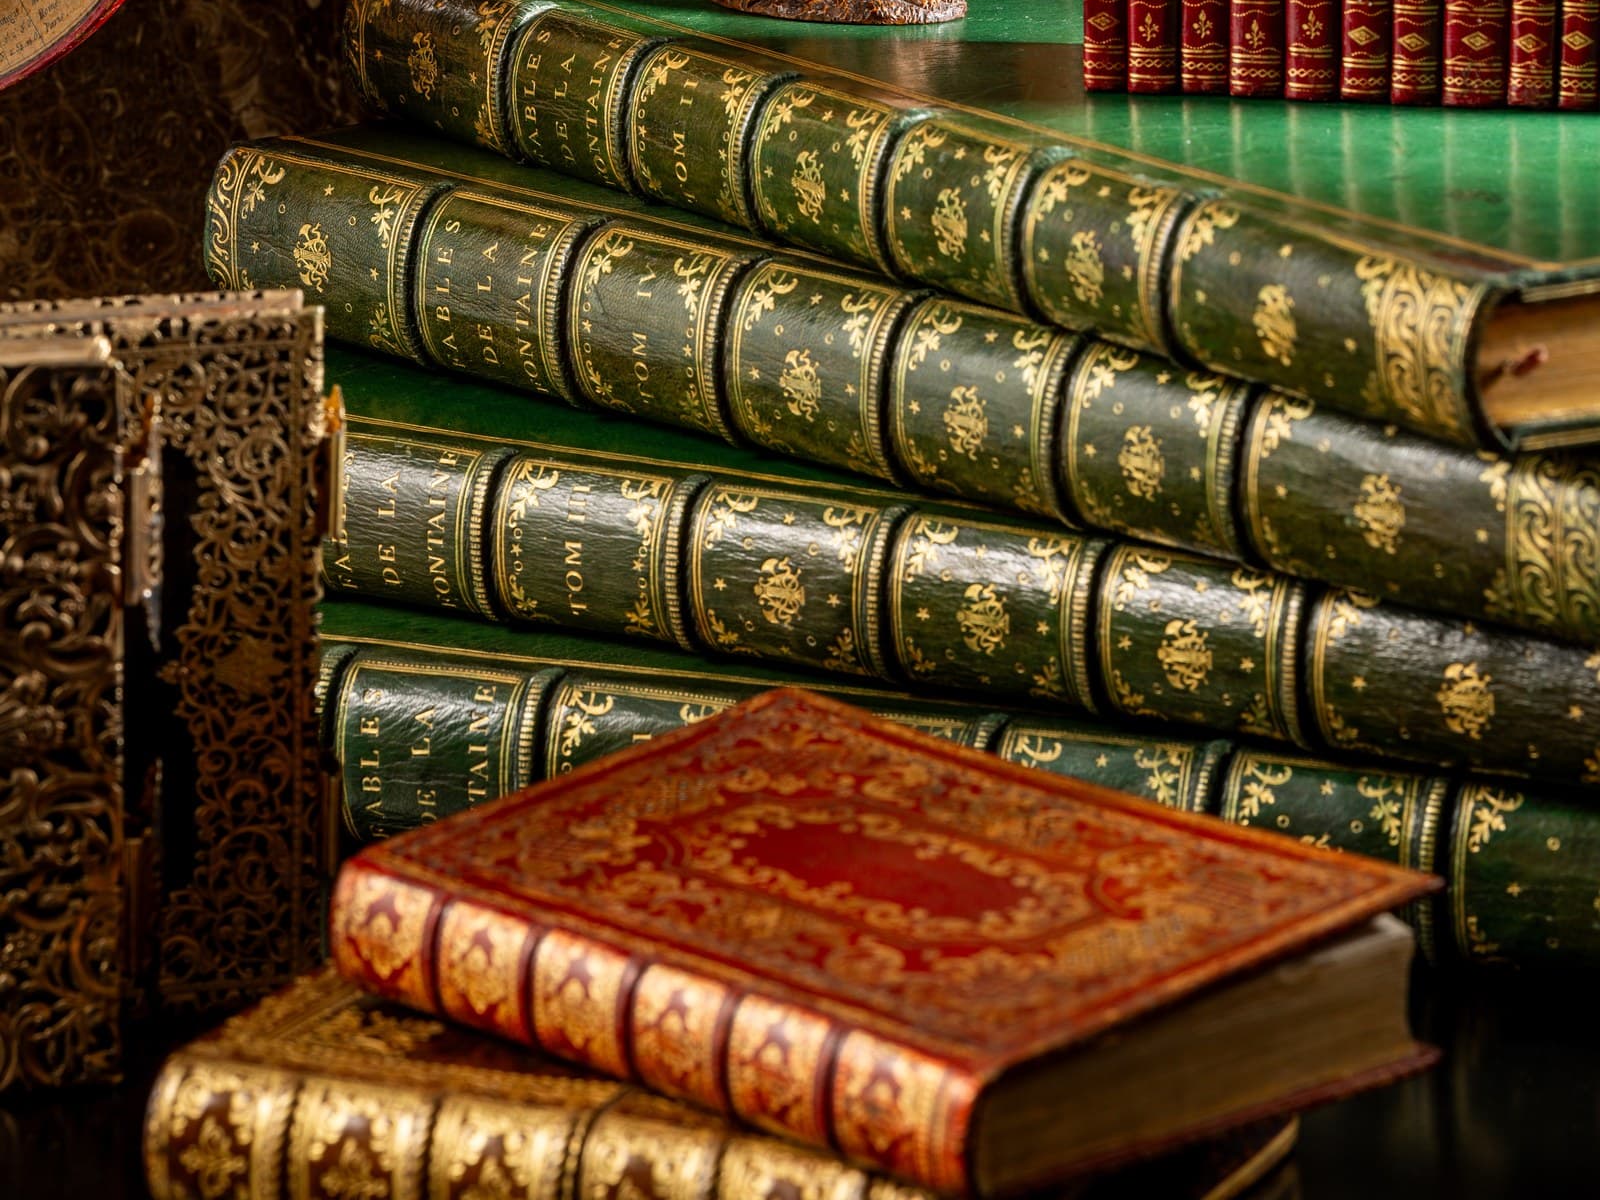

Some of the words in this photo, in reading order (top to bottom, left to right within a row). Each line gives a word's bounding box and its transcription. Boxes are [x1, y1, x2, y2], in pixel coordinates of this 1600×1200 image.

[554, 53, 576, 99] LA
[680, 79, 699, 106] II
[555, 121, 577, 166] DE
[673, 130, 698, 204] TOM
[435, 219, 467, 369] FABLES
[477, 241, 499, 294] LA
[636, 263, 658, 299] IV
[515, 223, 551, 394] FONTAINE
[479, 324, 500, 365] DE
[631, 332, 655, 404] TOM
[377, 471, 400, 518] LA
[568, 484, 591, 522] III
[427, 450, 460, 608] FONTAINE
[378, 544, 401, 585] DE
[564, 540, 588, 616] TOM
[411, 706, 436, 759] LA
[468, 685, 497, 803] TAINE
